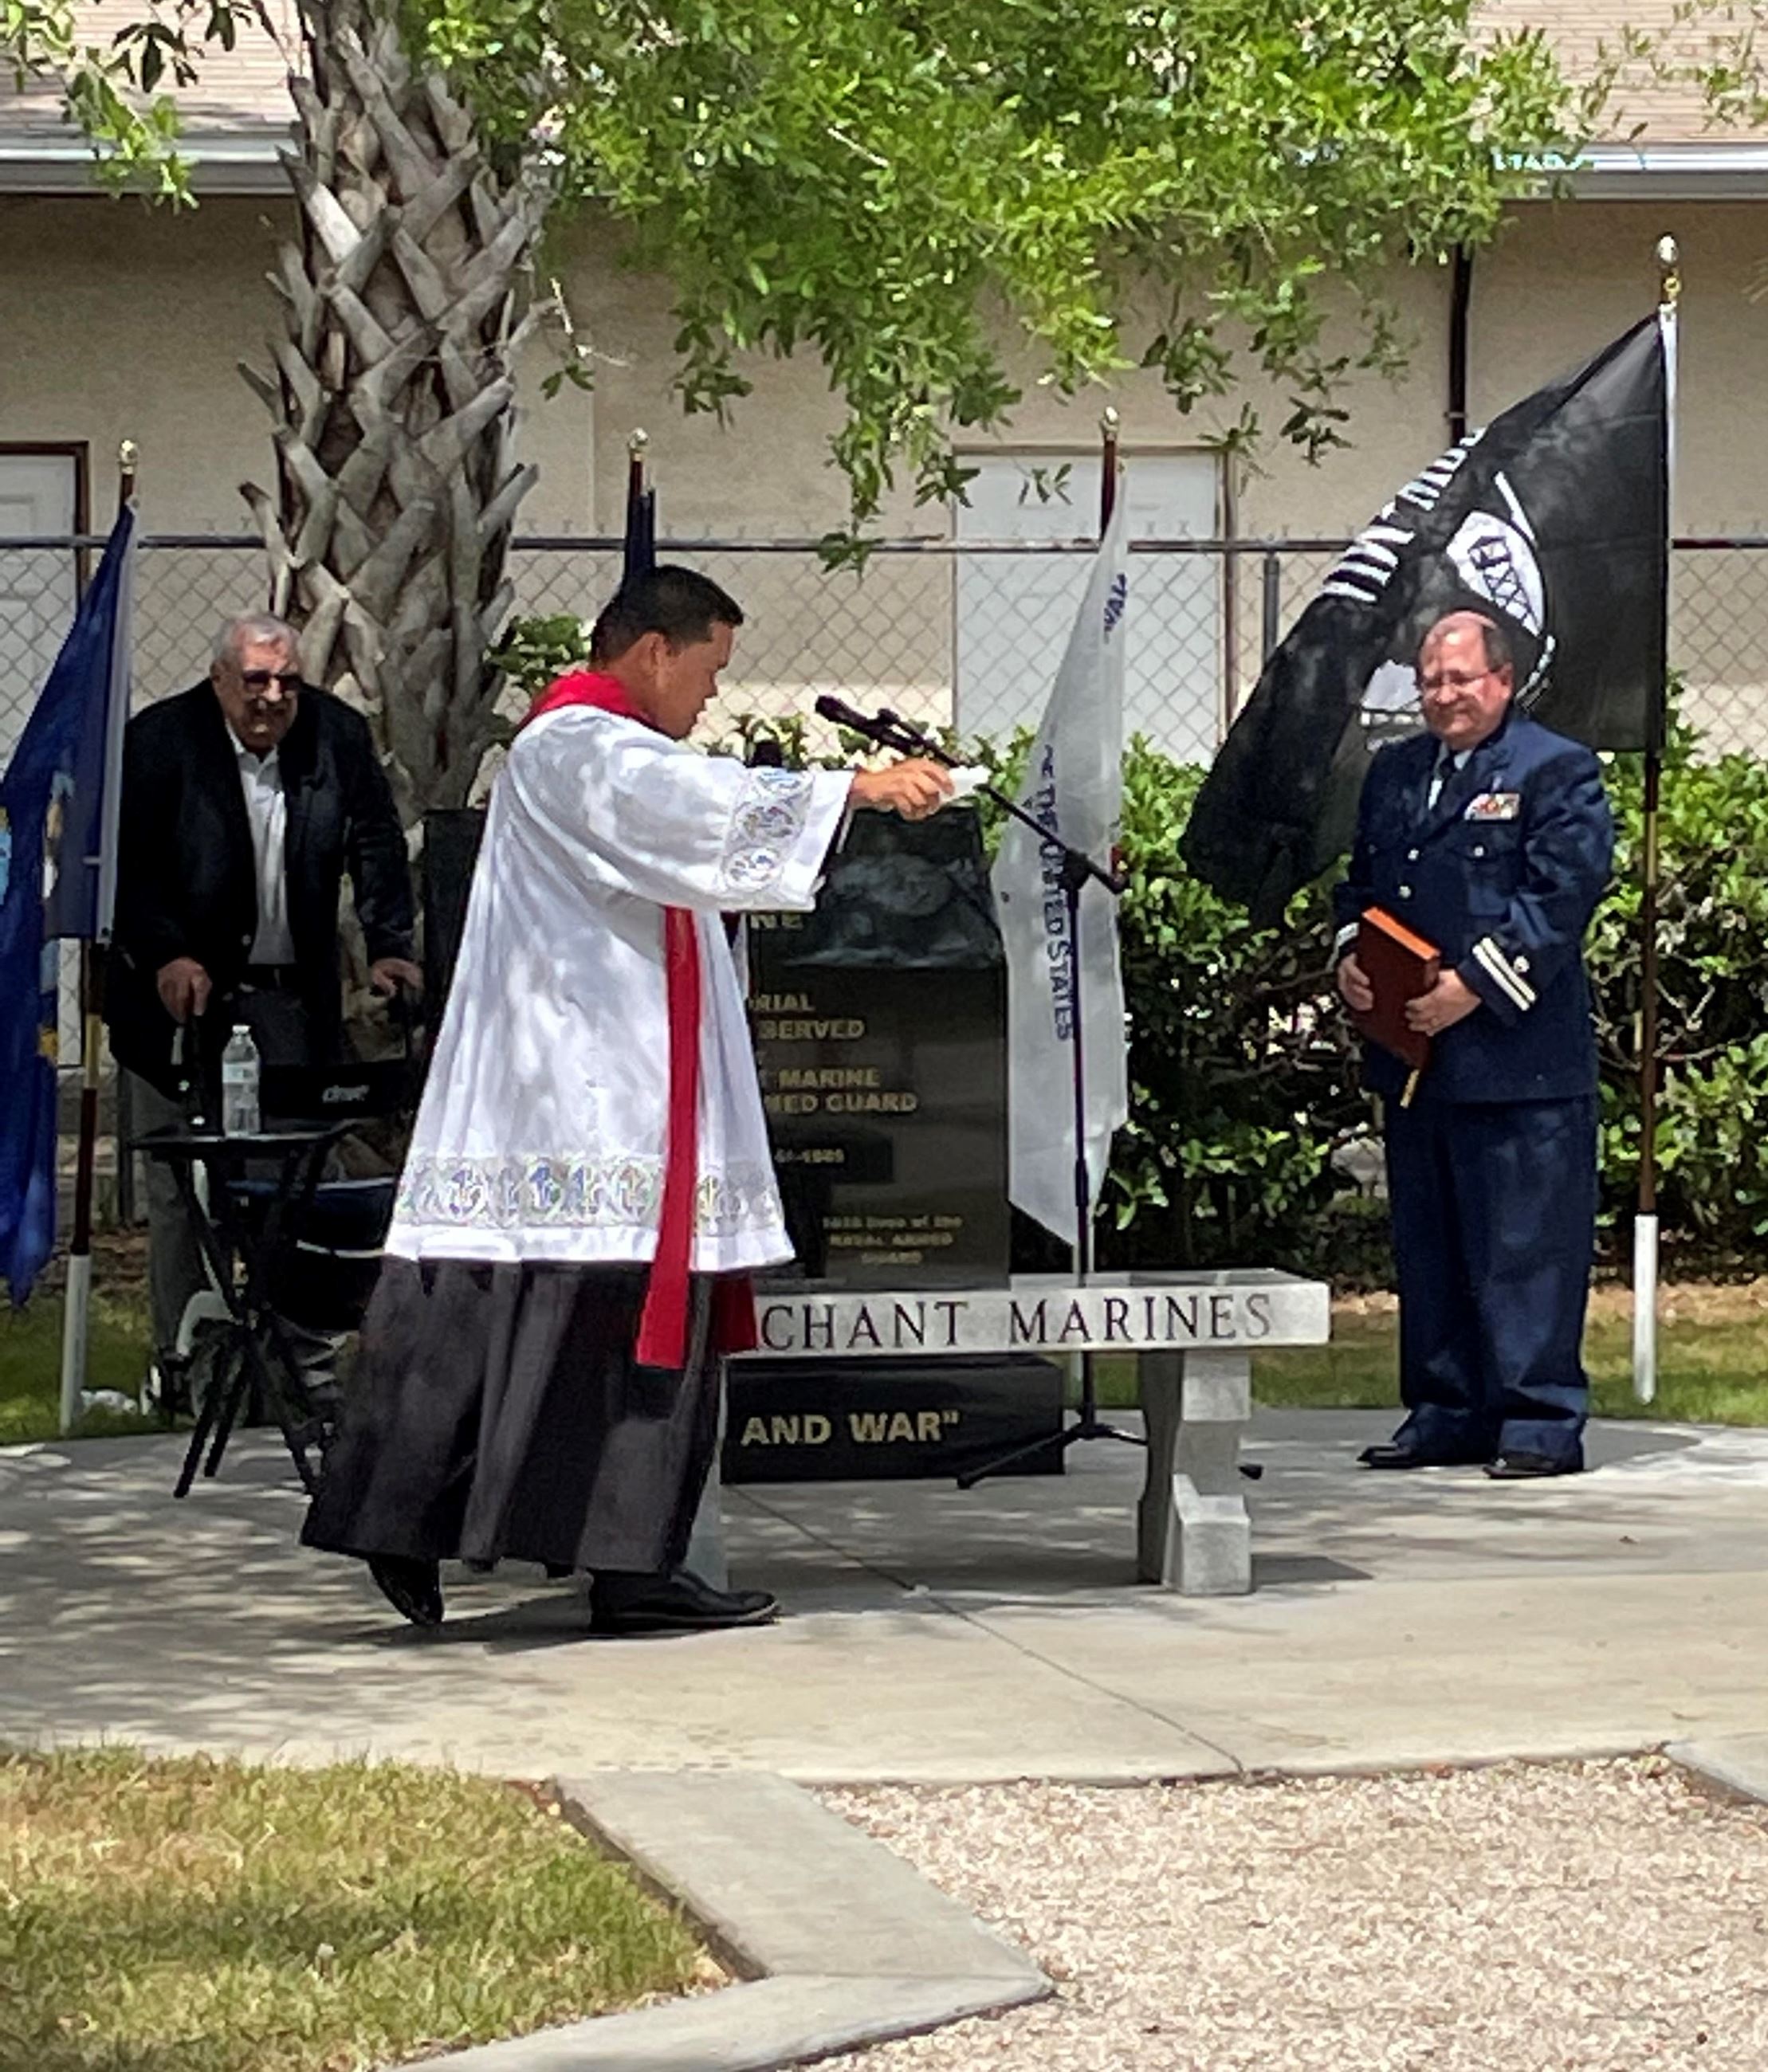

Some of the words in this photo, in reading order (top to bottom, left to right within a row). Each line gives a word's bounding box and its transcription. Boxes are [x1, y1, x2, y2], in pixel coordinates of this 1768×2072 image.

[758, 1019, 865, 1039] SERVED
[778, 1069, 880, 1088] MARINE
[826, 1092, 918, 1112] GUARD
[760, 1300, 970, 1351] CHANT
[1008, 1293, 1271, 1344] MARINES
[740, 1414, 832, 1447] AND
[847, 1410, 961, 1443] WAR"
